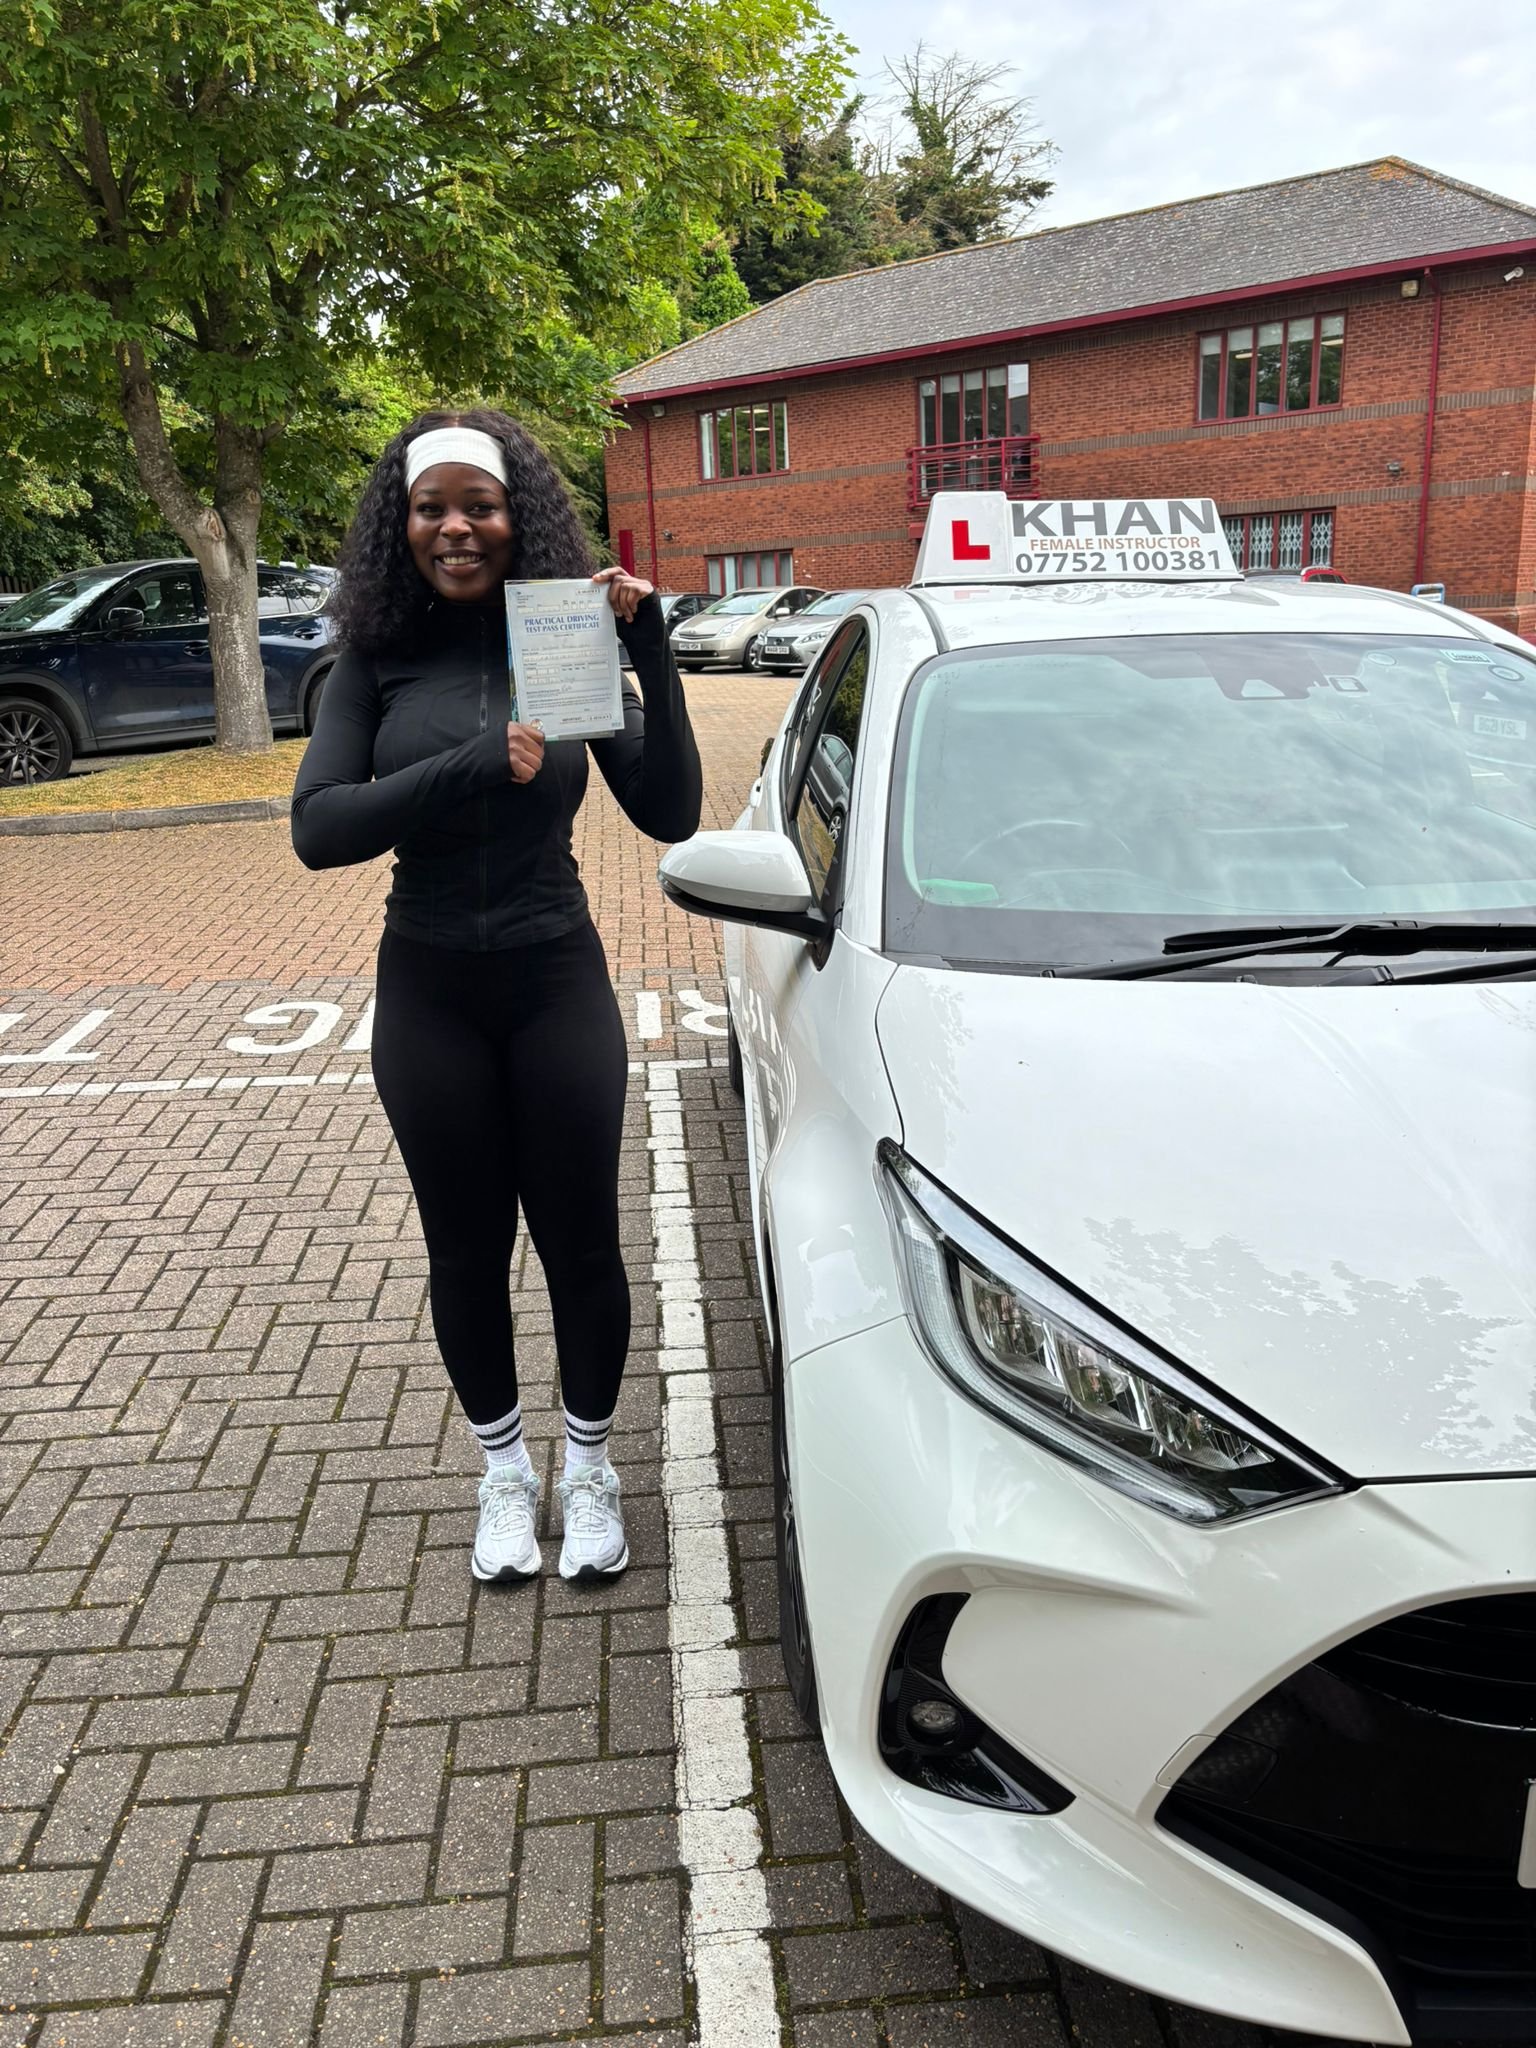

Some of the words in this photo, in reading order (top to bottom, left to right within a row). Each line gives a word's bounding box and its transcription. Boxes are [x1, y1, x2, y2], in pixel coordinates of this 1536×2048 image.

[1011, 500, 1216, 537] KHAN
[951, 519, 991, 560] L
[1030, 537, 1095, 551] FEMALE
[1098, 536, 1201, 550] INSTRUCTOR
[1015, 552, 1107, 574] 07752
[1113, 550, 1221, 572] 100381
[524, 616, 564, 626] PRACTICAL
[567, 613, 600, 623] DRIVING
[560, 621, 600, 631] CERTIFICATE
